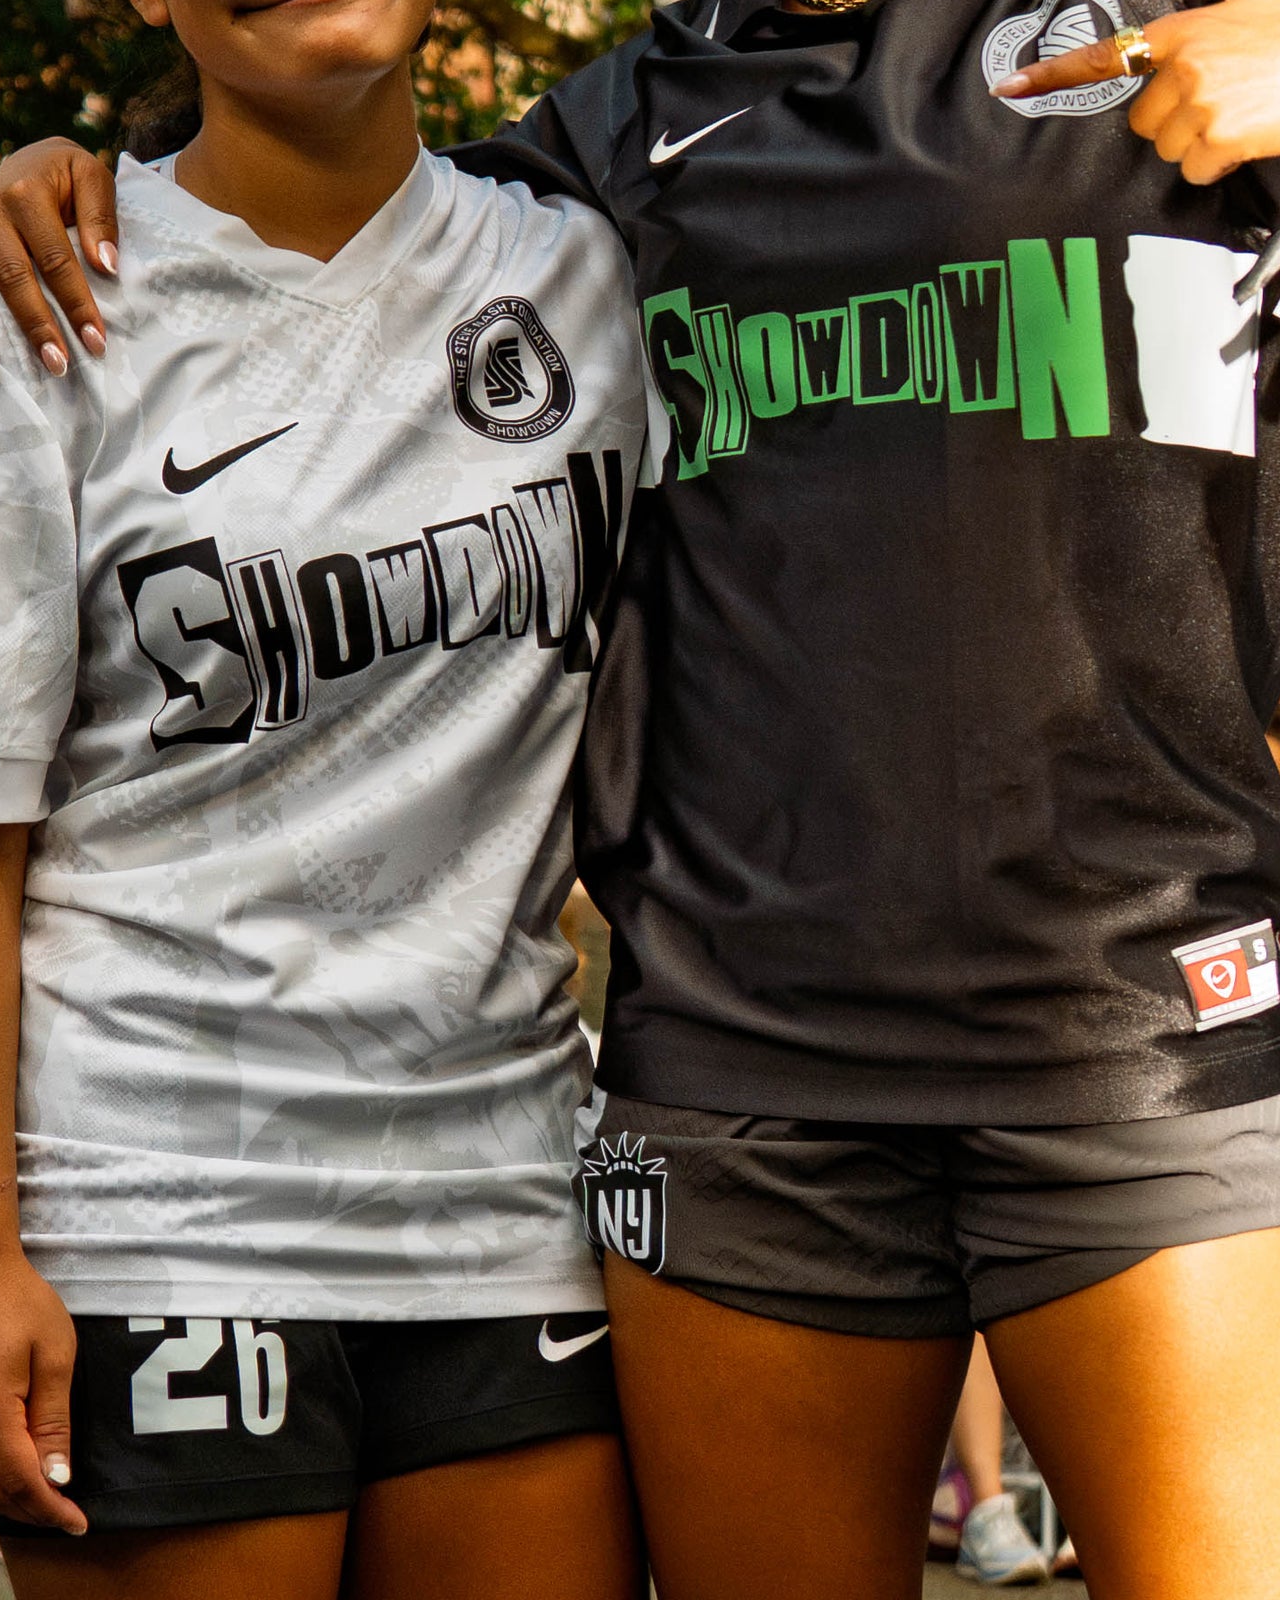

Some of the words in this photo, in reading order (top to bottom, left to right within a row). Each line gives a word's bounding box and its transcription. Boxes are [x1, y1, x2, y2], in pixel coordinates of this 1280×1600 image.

[998, 21, 1036, 49] STEVE
[992, 49, 1007, 73] THE
[1030, 78, 1125, 111] SHOWDOWN
[475, 302, 508, 328] NASH
[454, 327, 477, 356] STEVE
[456, 358, 467, 390] THE
[643, 236, 1111, 481] SHOWDOWN
[486, 407, 562, 437] SHOWDOWN
[117, 449, 623, 754] SHOWDOWN
[1252, 938, 1268, 962] S
[597, 1188, 652, 1260] NY
[127, 1317, 288, 1437] 26
